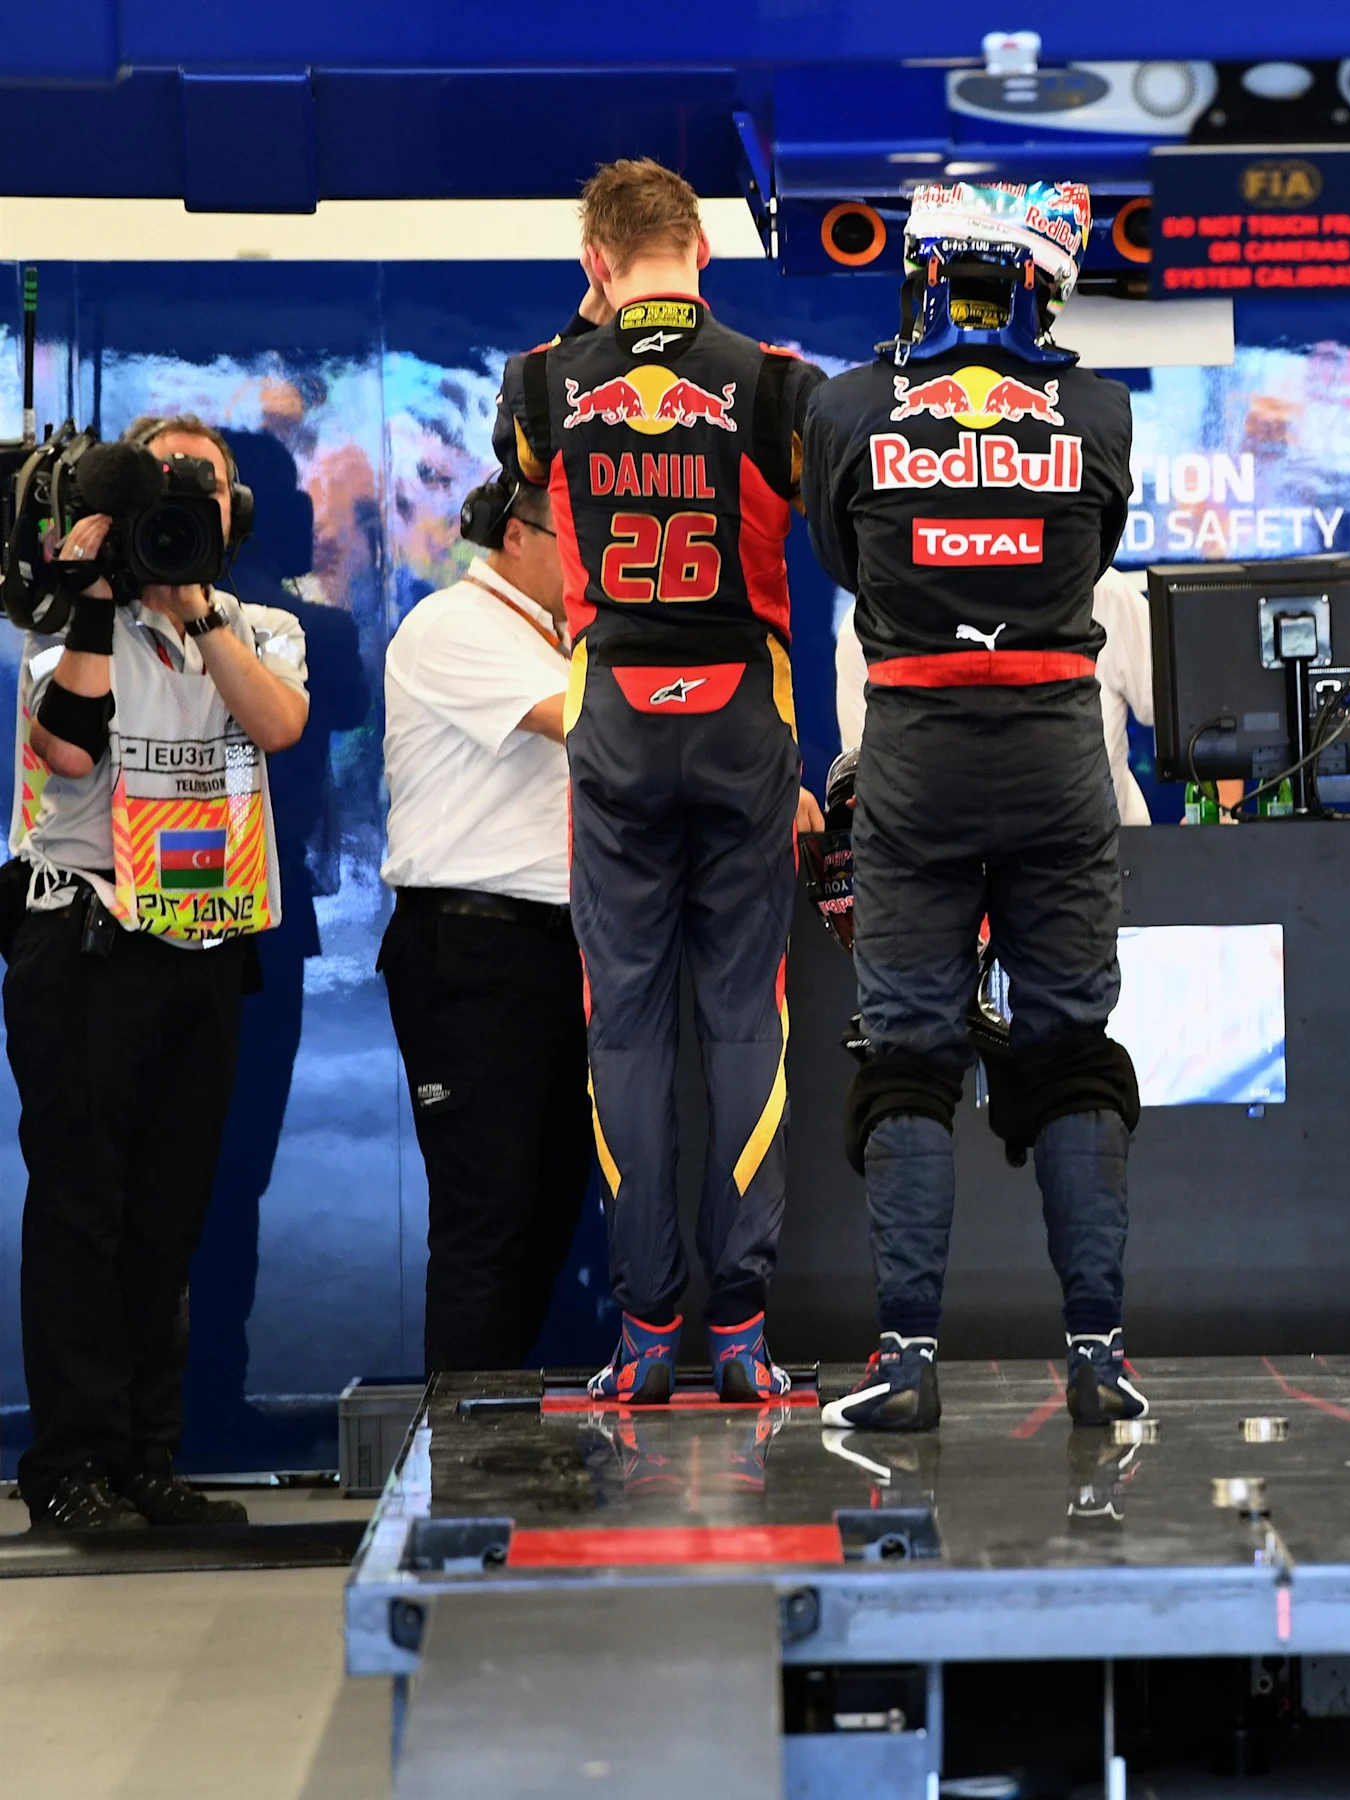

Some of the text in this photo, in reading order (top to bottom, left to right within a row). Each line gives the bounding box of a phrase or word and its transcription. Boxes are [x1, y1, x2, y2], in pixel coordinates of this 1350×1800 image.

[1243, 168, 1316, 200] FIA
[1025, 204, 1062, 240] Red
[1056, 218, 1082, 257] Bull
[1162, 216, 1196, 238] DO
[1198, 215, 1242, 236] NOT
[1246, 214, 1319, 236] TOUCH
[1208, 241, 1242, 263] OR
[1163, 267, 1253, 289] SYSTEM
[589, 452, 716, 499] DANIIL
[872, 434, 1081, 490] Red Bull
[1129, 452, 1255, 505] TION
[917, 527, 1041, 557] TOTAL
[1166, 507, 1345, 552] SAFETY
[601, 511, 722, 603] 26
[192, 895, 254, 923] LANE
